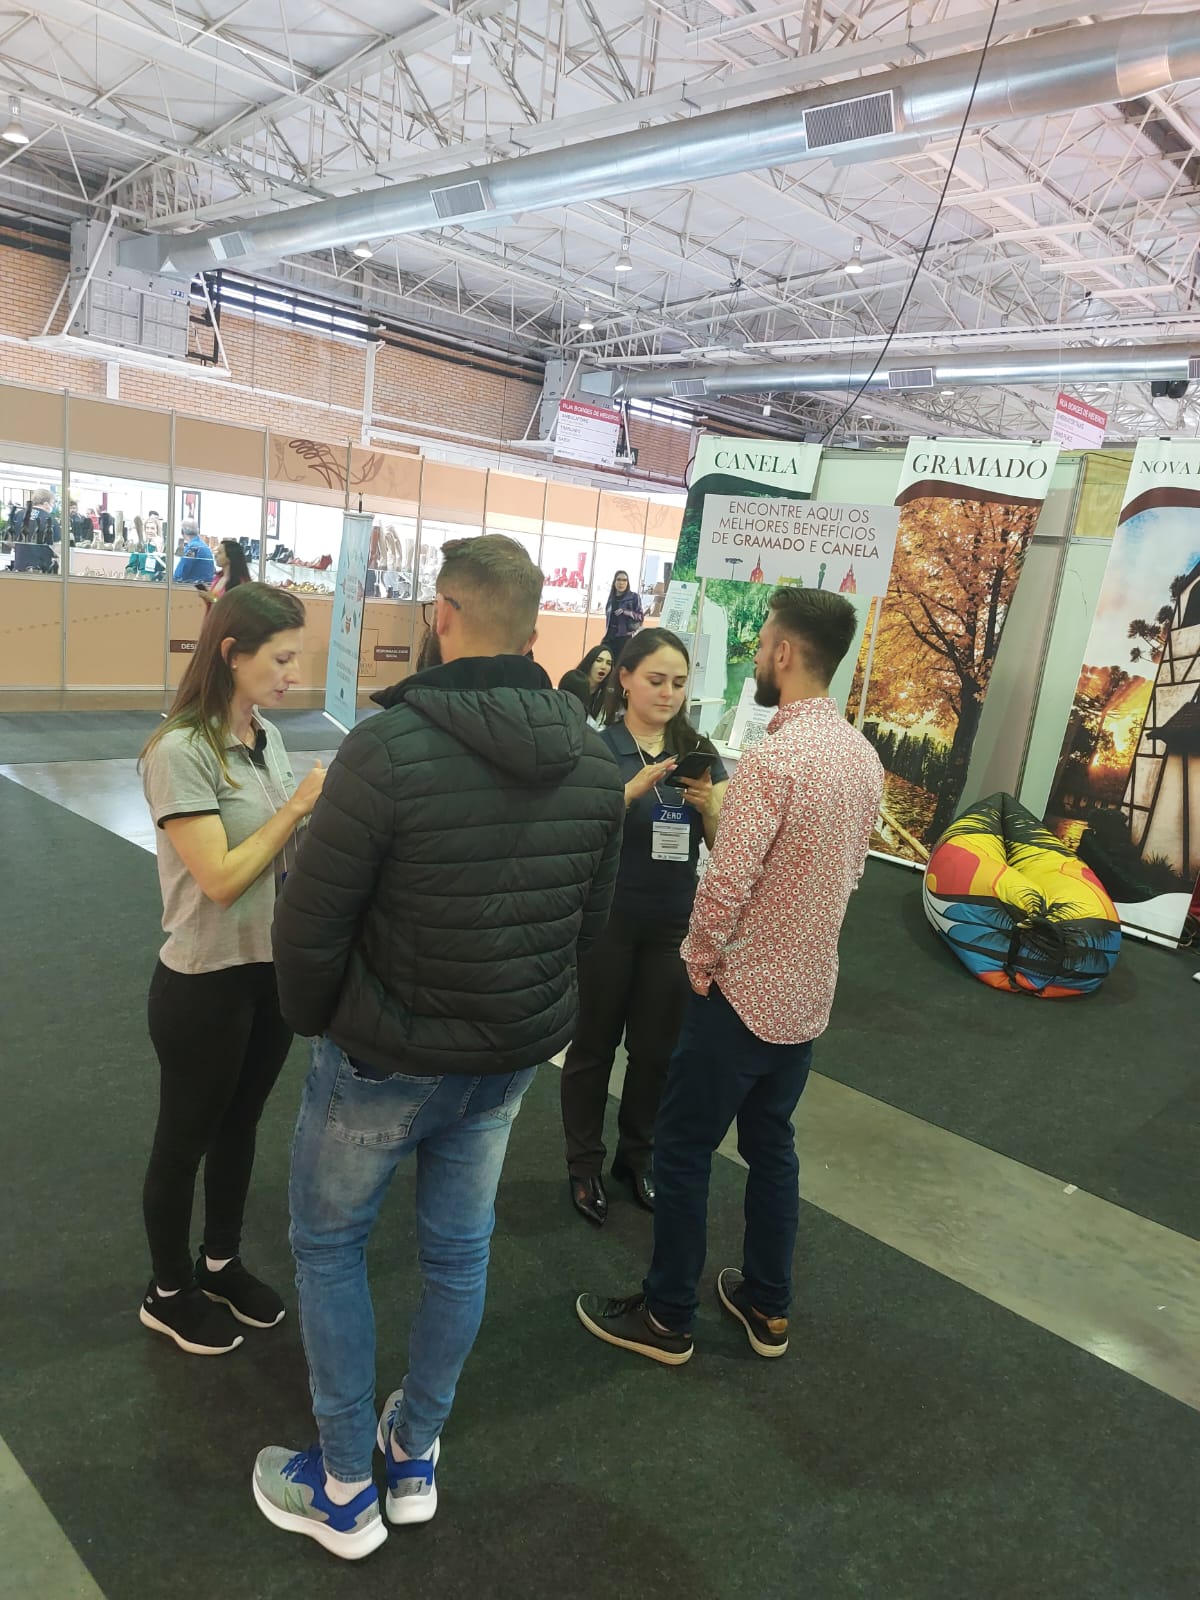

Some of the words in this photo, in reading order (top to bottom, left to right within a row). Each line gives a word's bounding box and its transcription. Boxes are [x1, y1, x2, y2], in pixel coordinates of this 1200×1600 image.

[714, 451, 798, 475] CANELA
[912, 454, 1048, 480] GRAMADO
[1139, 460, 1190, 474] NOVA
[730, 501, 802, 520] ENCONTRE
[806, 506, 844, 522] AQUI
[848, 509, 870, 524] OS
[719, 517, 789, 534] MELHORES
[794, 522, 876, 541] BENEFÍCIOS
[712, 531, 728, 545] DE
[733, 533, 805, 552] GRAMADO
[810, 540, 816, 552] E
[821, 540, 879, 559] CANELA
